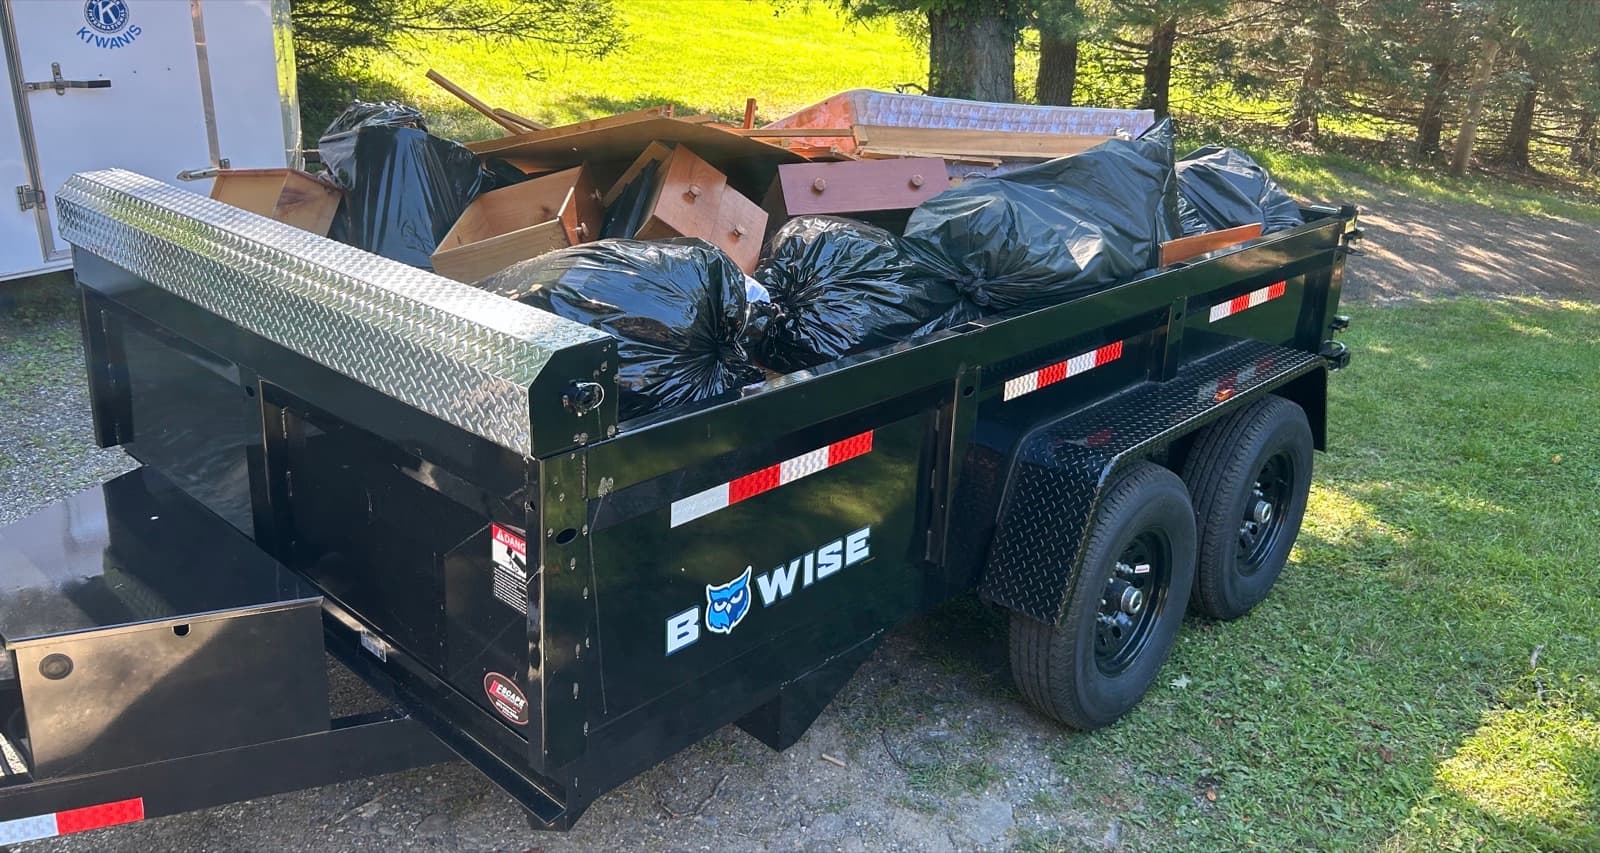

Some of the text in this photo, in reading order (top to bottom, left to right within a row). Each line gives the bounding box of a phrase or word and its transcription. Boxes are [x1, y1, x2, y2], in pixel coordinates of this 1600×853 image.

[76, 24, 142, 49] KIWANIS
[756, 525, 871, 608] WISE
[496, 683, 527, 710] ESCAPE
